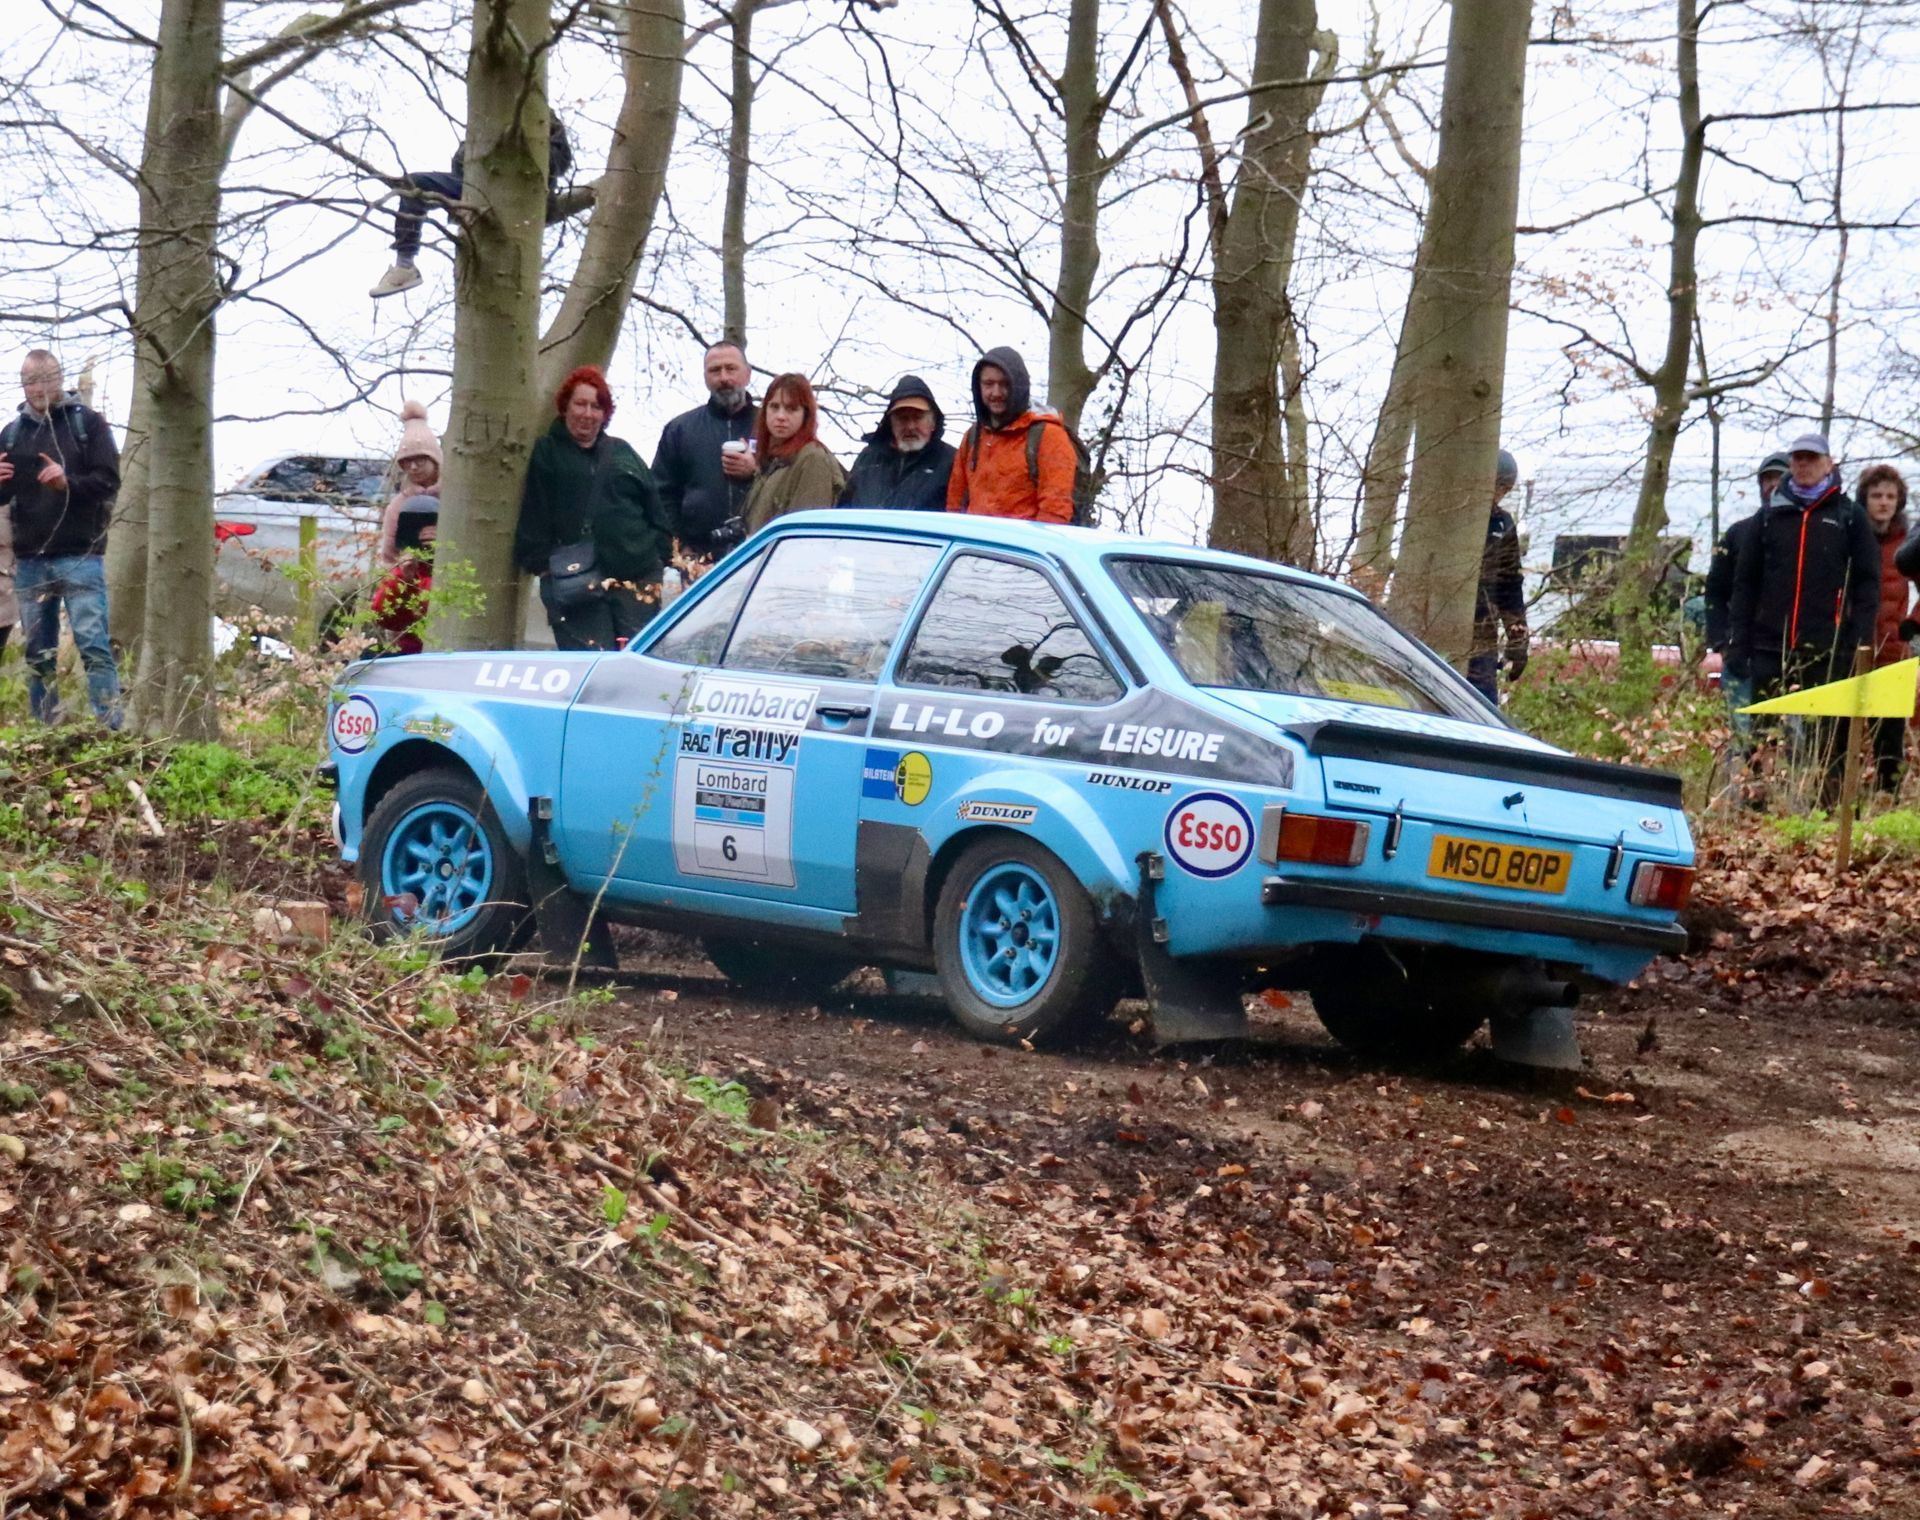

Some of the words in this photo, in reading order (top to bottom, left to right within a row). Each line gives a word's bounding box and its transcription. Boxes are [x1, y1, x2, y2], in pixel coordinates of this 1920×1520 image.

[474, 662, 571, 693] LI-LO
[692, 680, 816, 722] Lombard
[681, 731, 710, 752] RAC
[715, 727, 799, 761] rally
[889, 703, 1004, 738] LI-LO
[1032, 717, 1075, 747] for
[1099, 723, 1225, 762] LEISURE
[696, 767, 768, 793] Lombard
[1087, 771, 1172, 793] DUNLOP
[970, 805, 1034, 820] DUNLOP
[722, 835, 738, 862] 6
[1442, 841, 1497, 880] MSO
[1505, 853, 1561, 887] 80P
